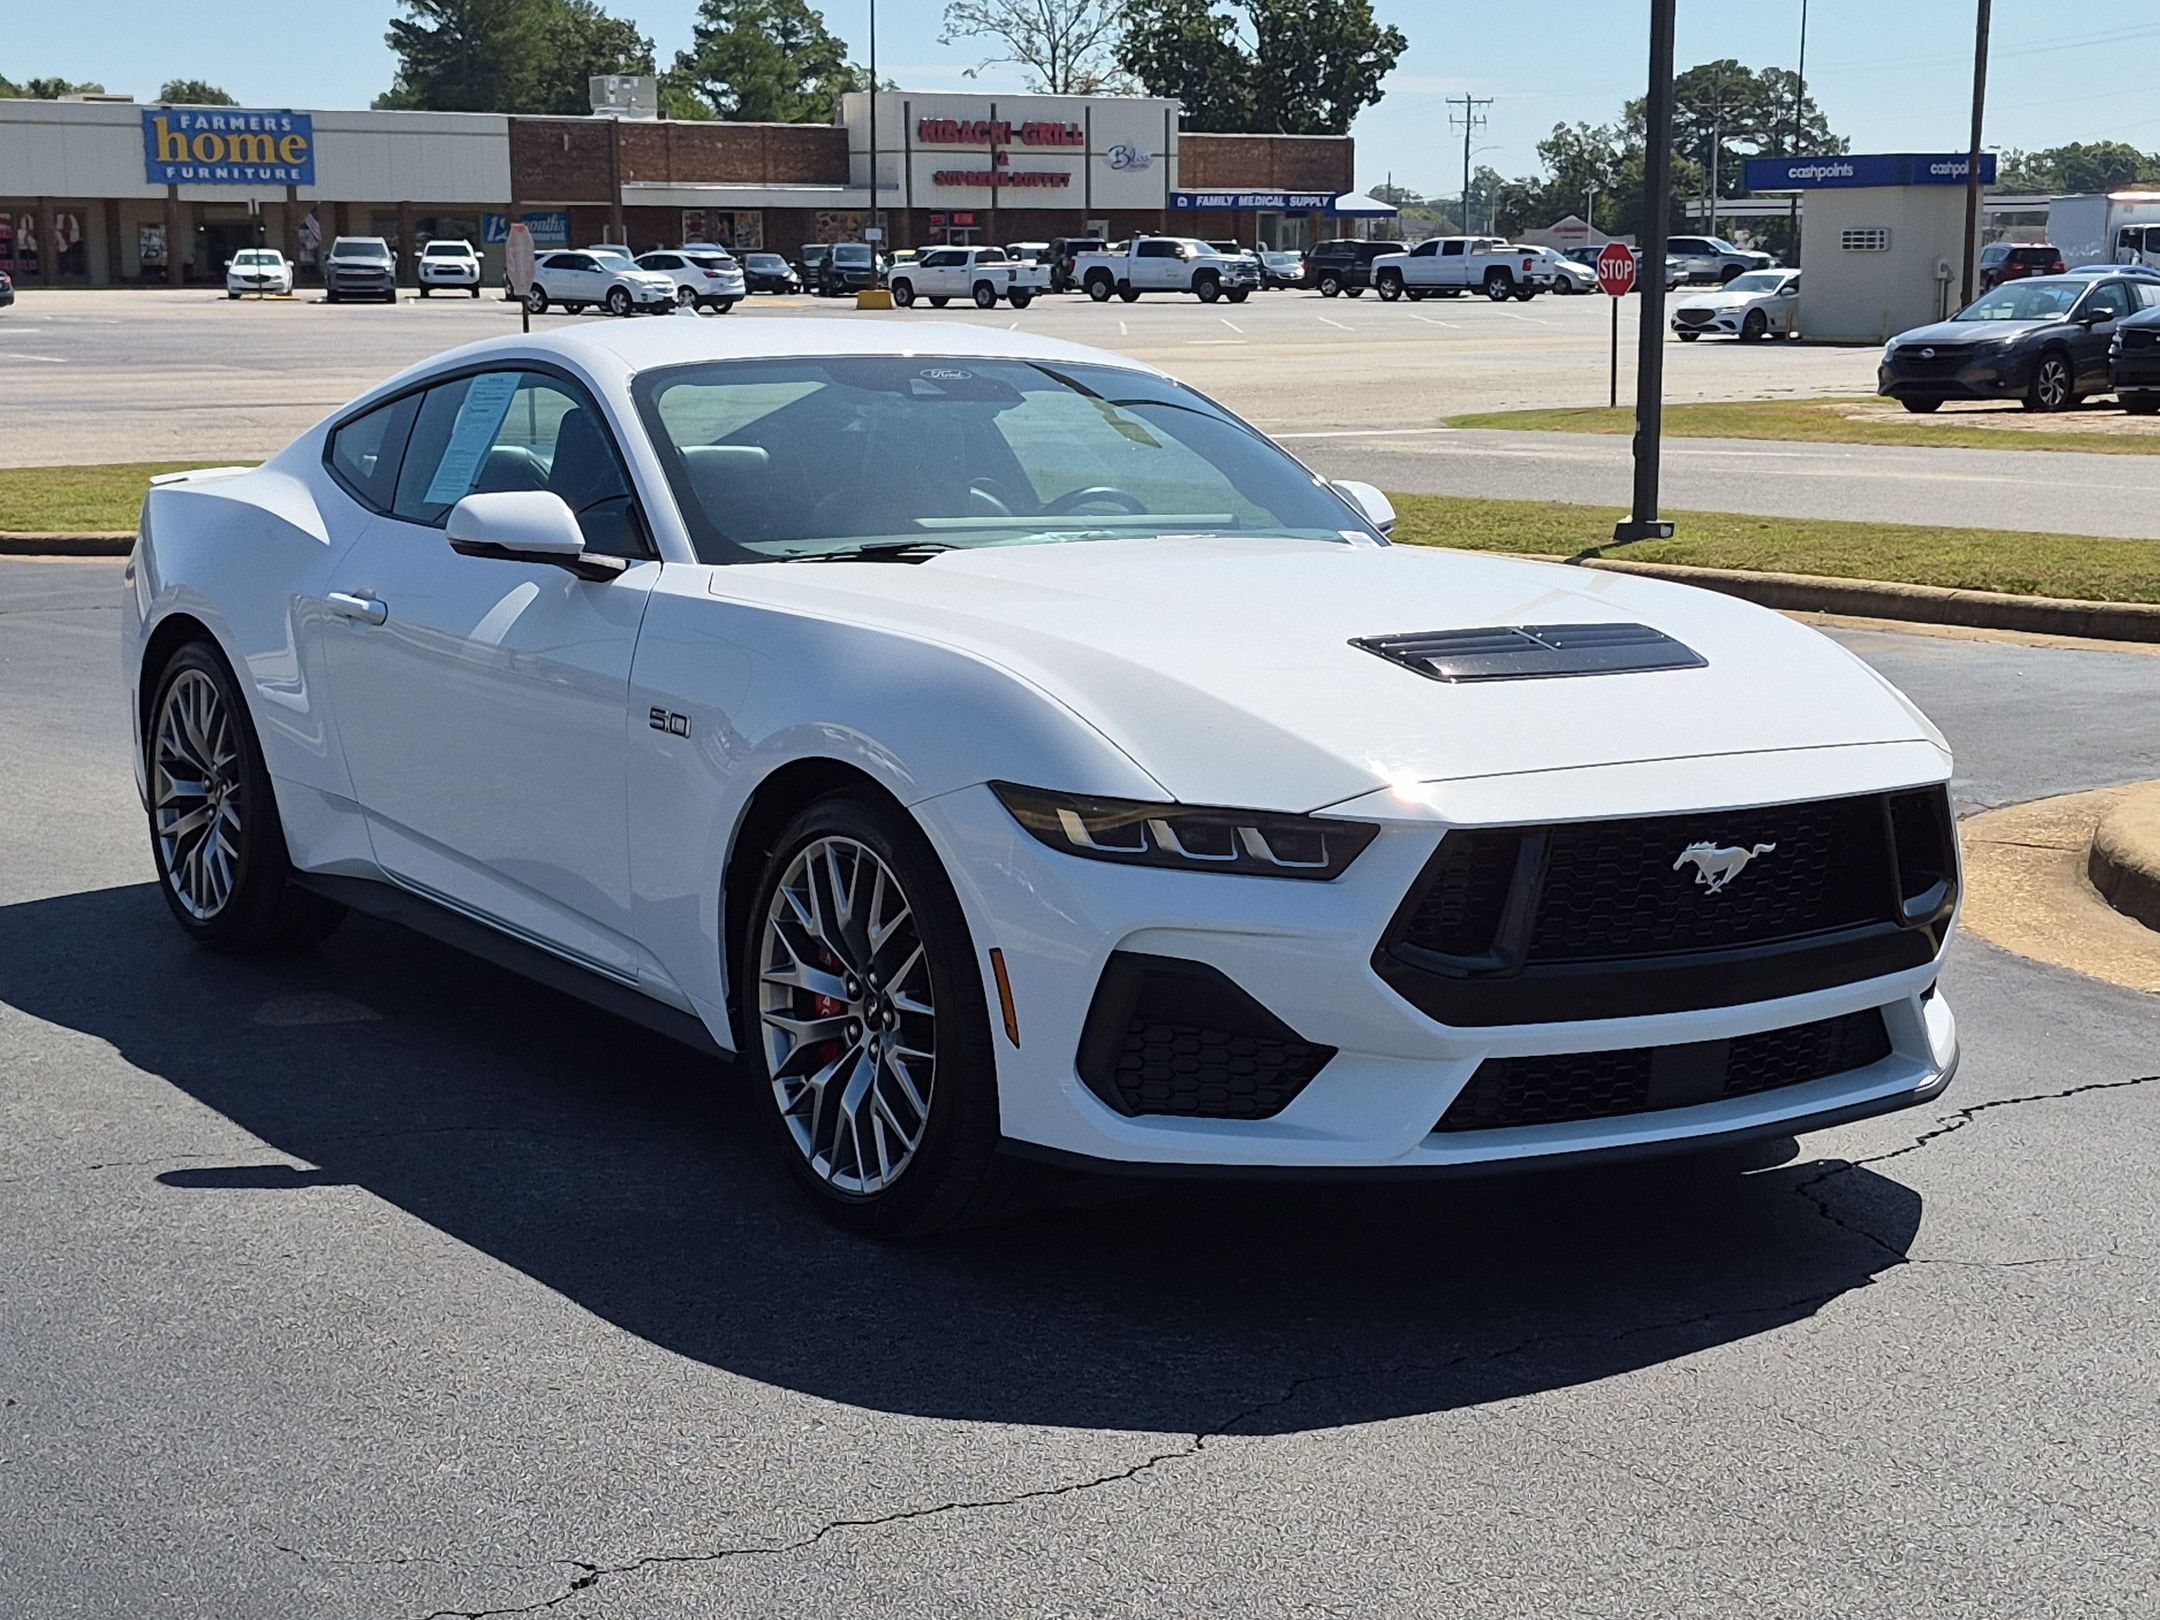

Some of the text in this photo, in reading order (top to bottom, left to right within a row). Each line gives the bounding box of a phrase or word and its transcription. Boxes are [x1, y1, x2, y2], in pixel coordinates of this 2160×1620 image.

[180, 116, 292, 131] FARMERS
[919, 118, 1084, 146] HIBACHI GRILL
[152, 116, 308, 165] home
[166, 166, 300, 180] FURNITURE
[1014, 172, 1071, 188] BUFFET
[1788, 162, 1854, 182] cashpoints
[1196, 195, 1330, 208] FAMILY MEDICAL SUPPLY
[1600, 259, 1633, 280] STOP
